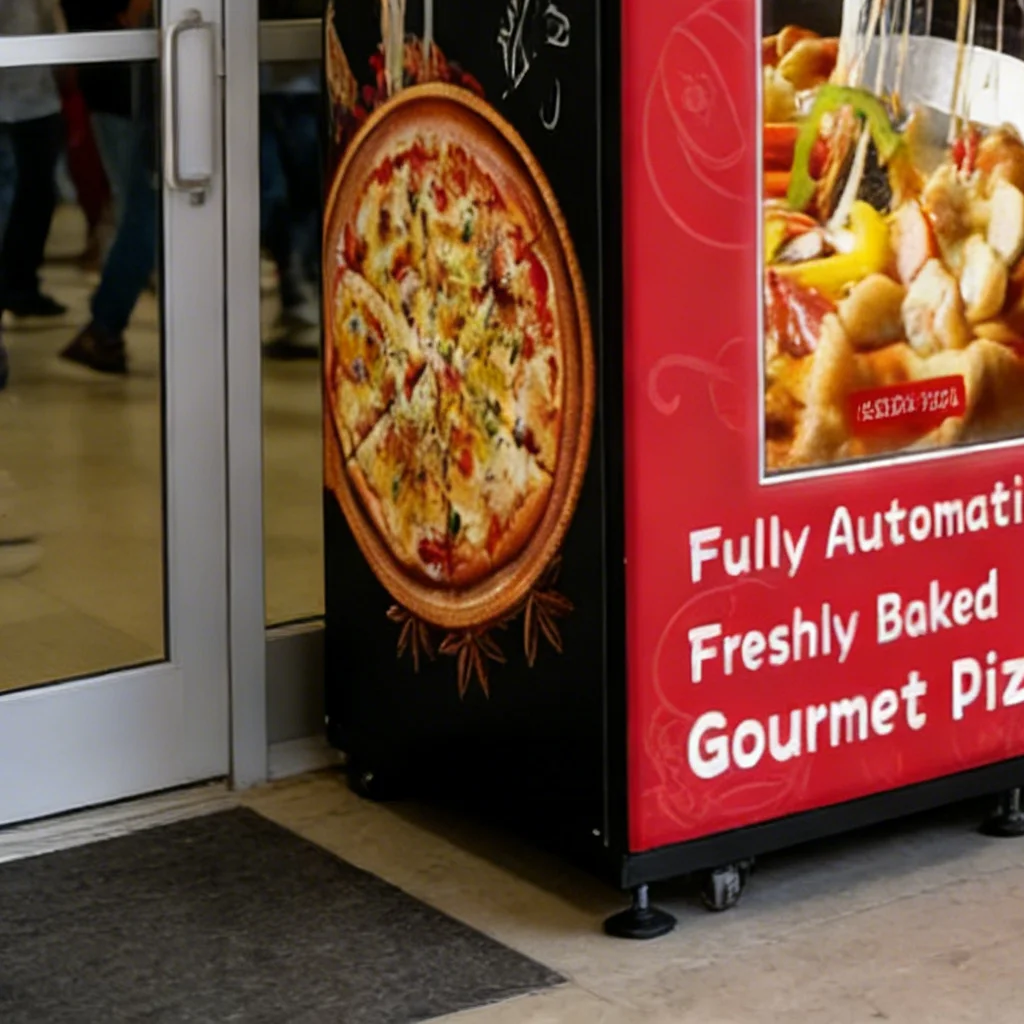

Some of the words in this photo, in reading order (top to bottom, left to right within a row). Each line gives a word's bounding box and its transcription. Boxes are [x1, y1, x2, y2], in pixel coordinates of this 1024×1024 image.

[689, 515, 811, 583] Fully
[688, 603, 859, 684] Freshly
[876, 568, 999, 645] Baked
[688, 671, 928, 779] Gourmet
